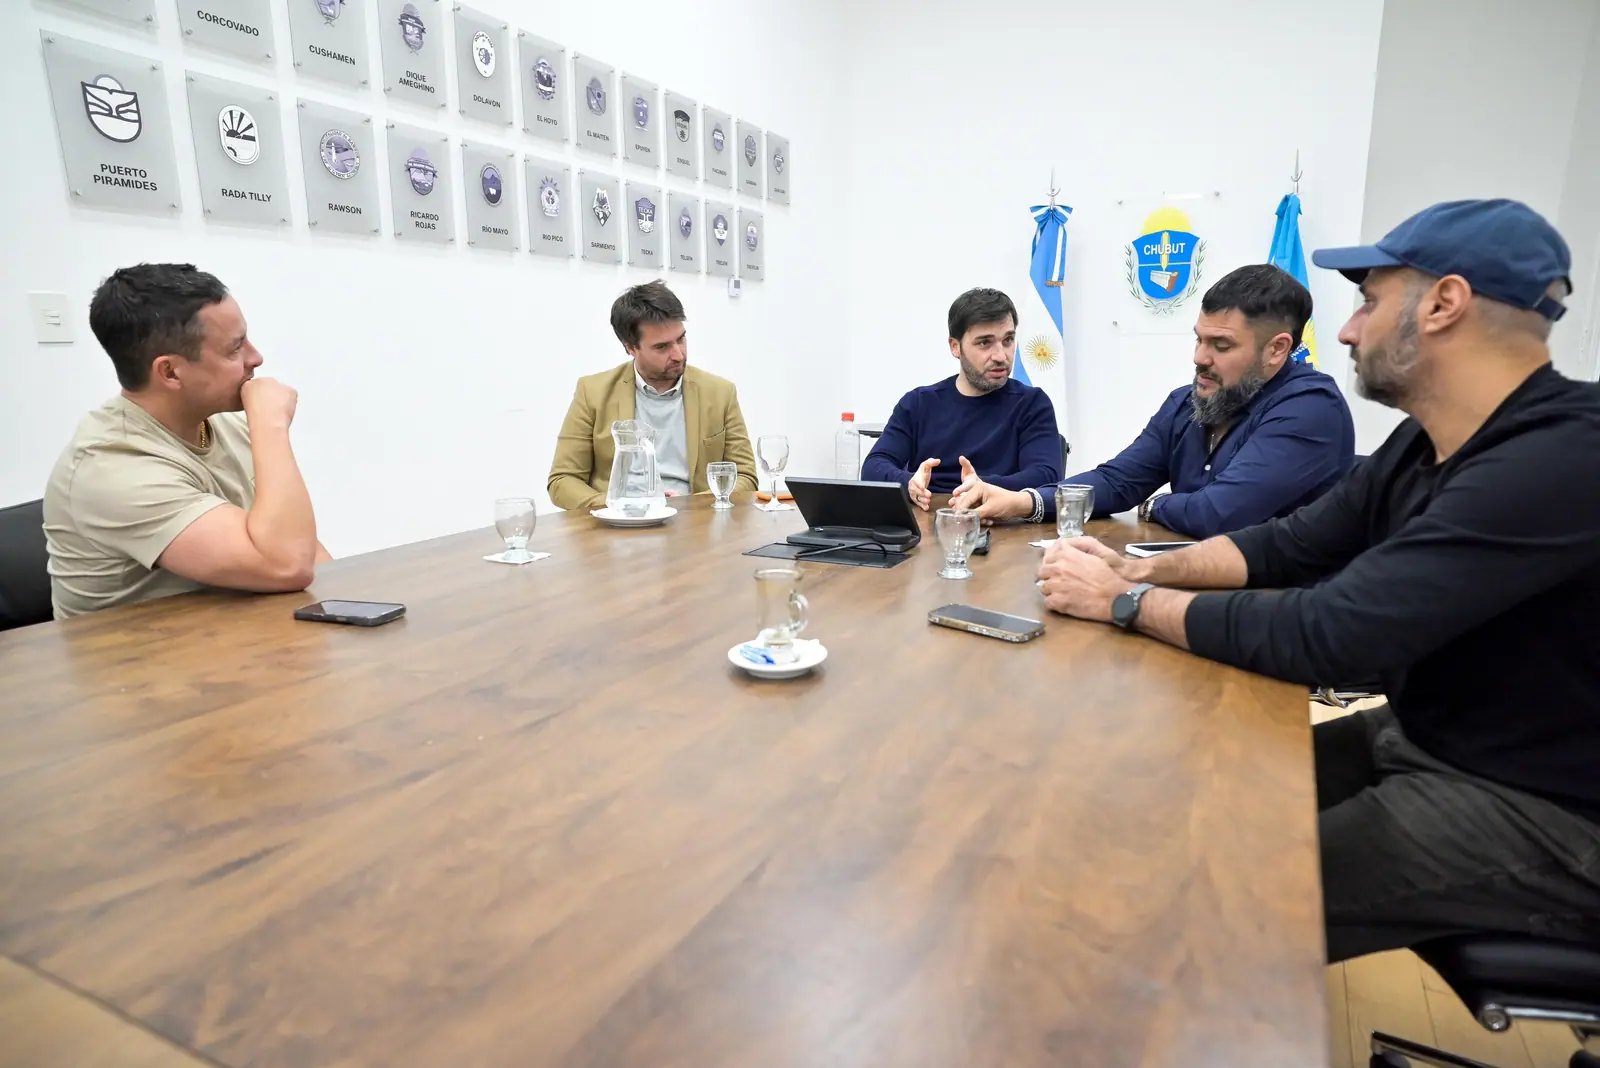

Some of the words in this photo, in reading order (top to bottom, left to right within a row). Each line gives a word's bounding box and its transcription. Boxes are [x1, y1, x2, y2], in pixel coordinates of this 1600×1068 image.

[197, 10, 260, 37] CORCOVADO
[308, 44, 356, 66] CUSHAMEN
[405, 70, 427, 83] DIQUE
[398, 77, 435, 94] AMEGHINO
[473, 94, 501, 109] DOLAVON
[536, 114, 543, 122] EL
[543, 116, 558, 126] HOYO
[100, 163, 148, 179] PUERTO
[93, 174, 158, 191] PIRAMIDES
[221, 188, 248, 200] RADA
[248, 191, 272, 203] TILLY
[328, 202, 362, 215] RAWSON
[410, 210, 440, 222] RICARDO
[414, 220, 437, 231] ROJAS
[481, 224, 492, 234] RÍO
[492, 227, 509, 236] MAYO
[551, 235, 564, 243] PICO
[590, 241, 616, 251] SARMIENTO
[1143, 242, 1186, 256] CHUBUT
